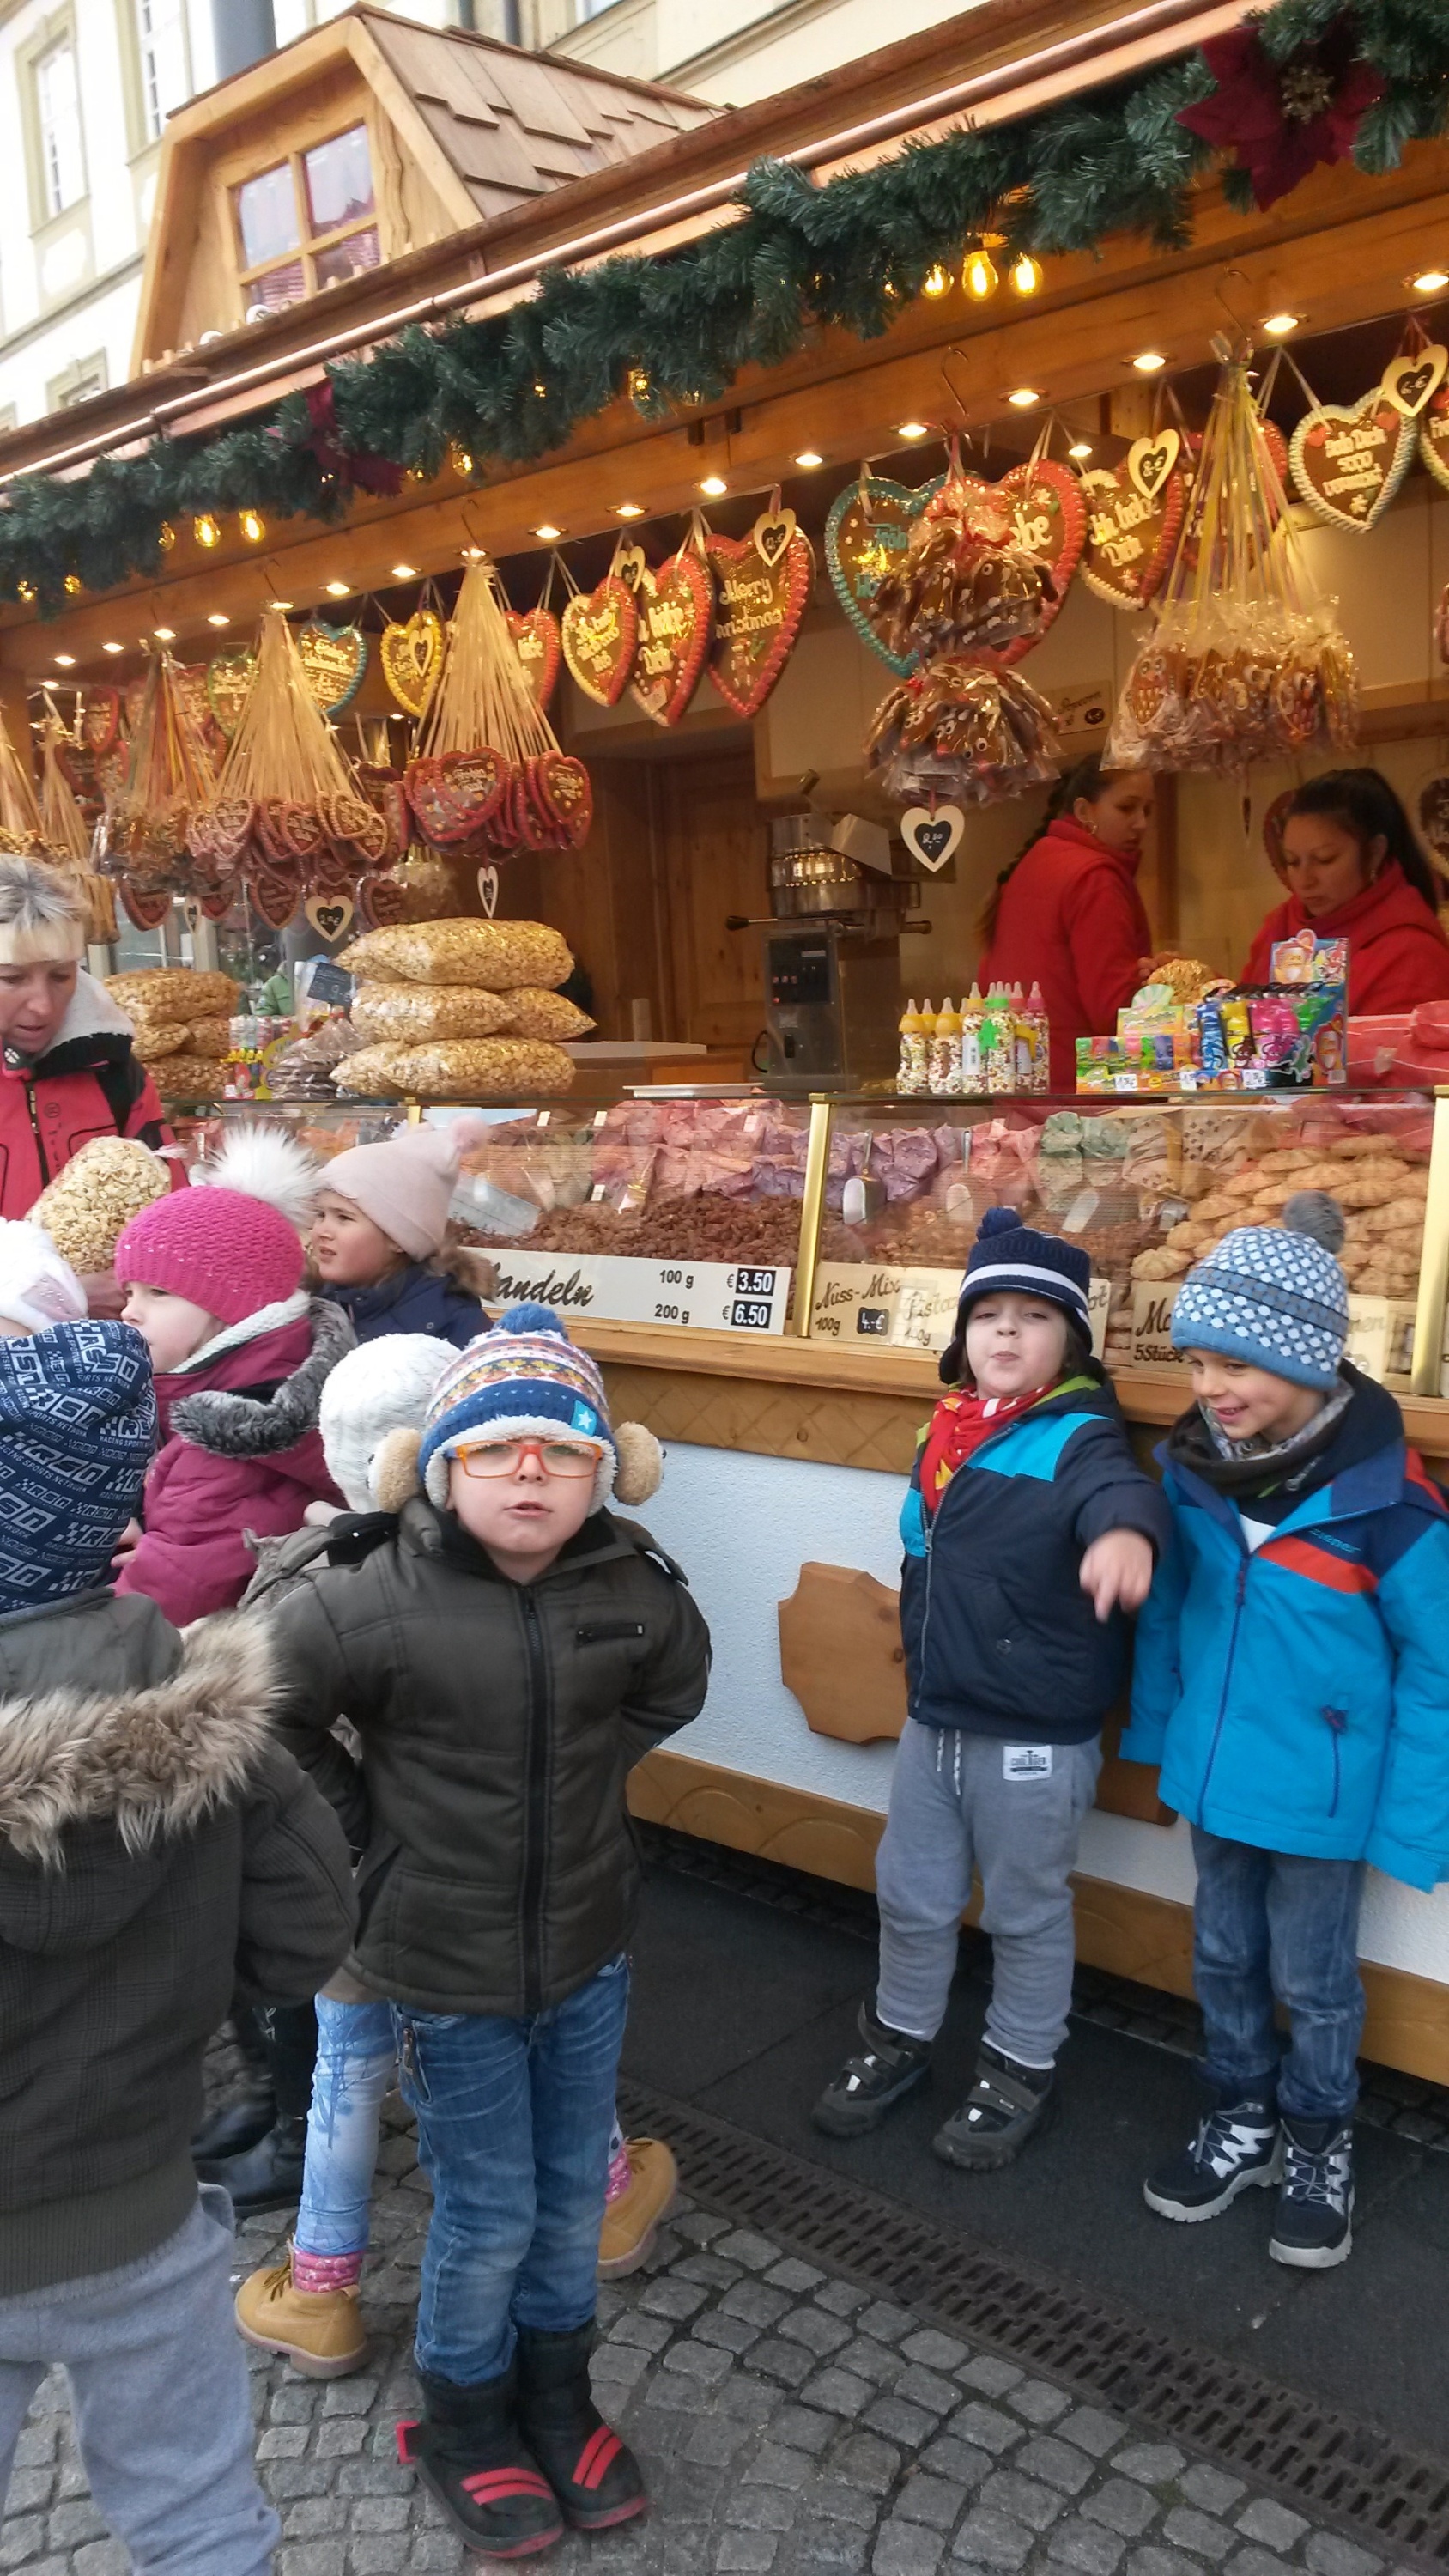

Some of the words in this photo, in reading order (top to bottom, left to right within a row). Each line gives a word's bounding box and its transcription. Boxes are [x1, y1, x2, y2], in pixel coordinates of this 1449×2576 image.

[718, 577, 773, 605] Merry
[492, 1262, 594, 1307] andeln
[659, 1269, 685, 1285] 100
[686, 1273, 694, 1289] g
[725, 1273, 735, 1289] €
[737, 1272, 773, 1294] 3.50
[654, 1303, 679, 1321] 200
[681, 1309, 690, 1324] g
[721, 1305, 731, 1321] €
[734, 1303, 767, 1325] 6.50
[815, 1316, 841, 1336] 100g
[99, 1435, 123, 1446] RACING
[21, 1443, 112, 1486] RSN
[22, 1458, 54, 1479] SPORTS
[74, 1525, 129, 1548] RS
